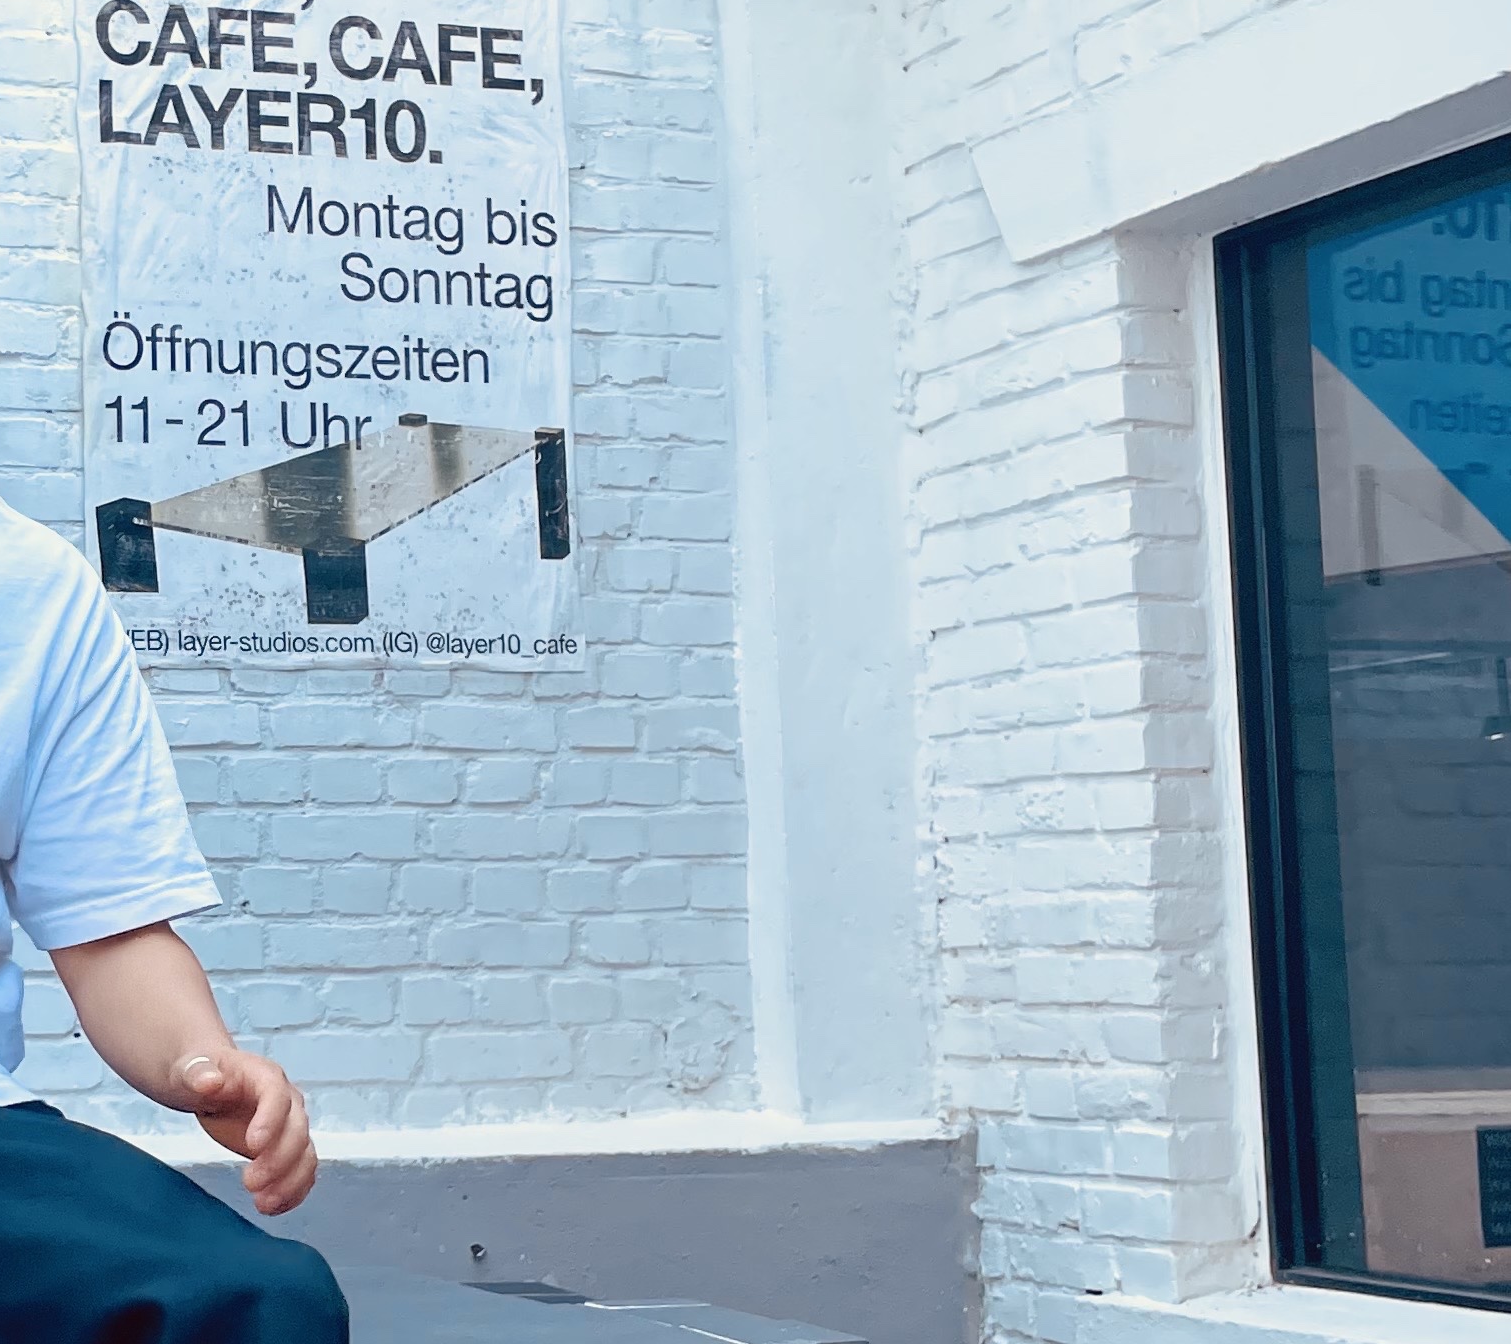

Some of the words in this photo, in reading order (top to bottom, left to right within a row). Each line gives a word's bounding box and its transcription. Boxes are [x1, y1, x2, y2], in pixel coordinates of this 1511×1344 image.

[98, 80, 442, 163] LAYER10.
[267, 185, 463, 254] Montag
[487, 198, 558, 247] bis
[341, 255, 553, 322] Sonntag
[102, 311, 489, 389] Öffnungszeiten
[280, 401, 372, 450] Uhr
[126, 629, 169, 656] EB)
[178, 630, 374, 656] layer-studios.com
[382, 631, 419, 656] (IG)
[427, 632, 578, 659] @layer10_cafe
